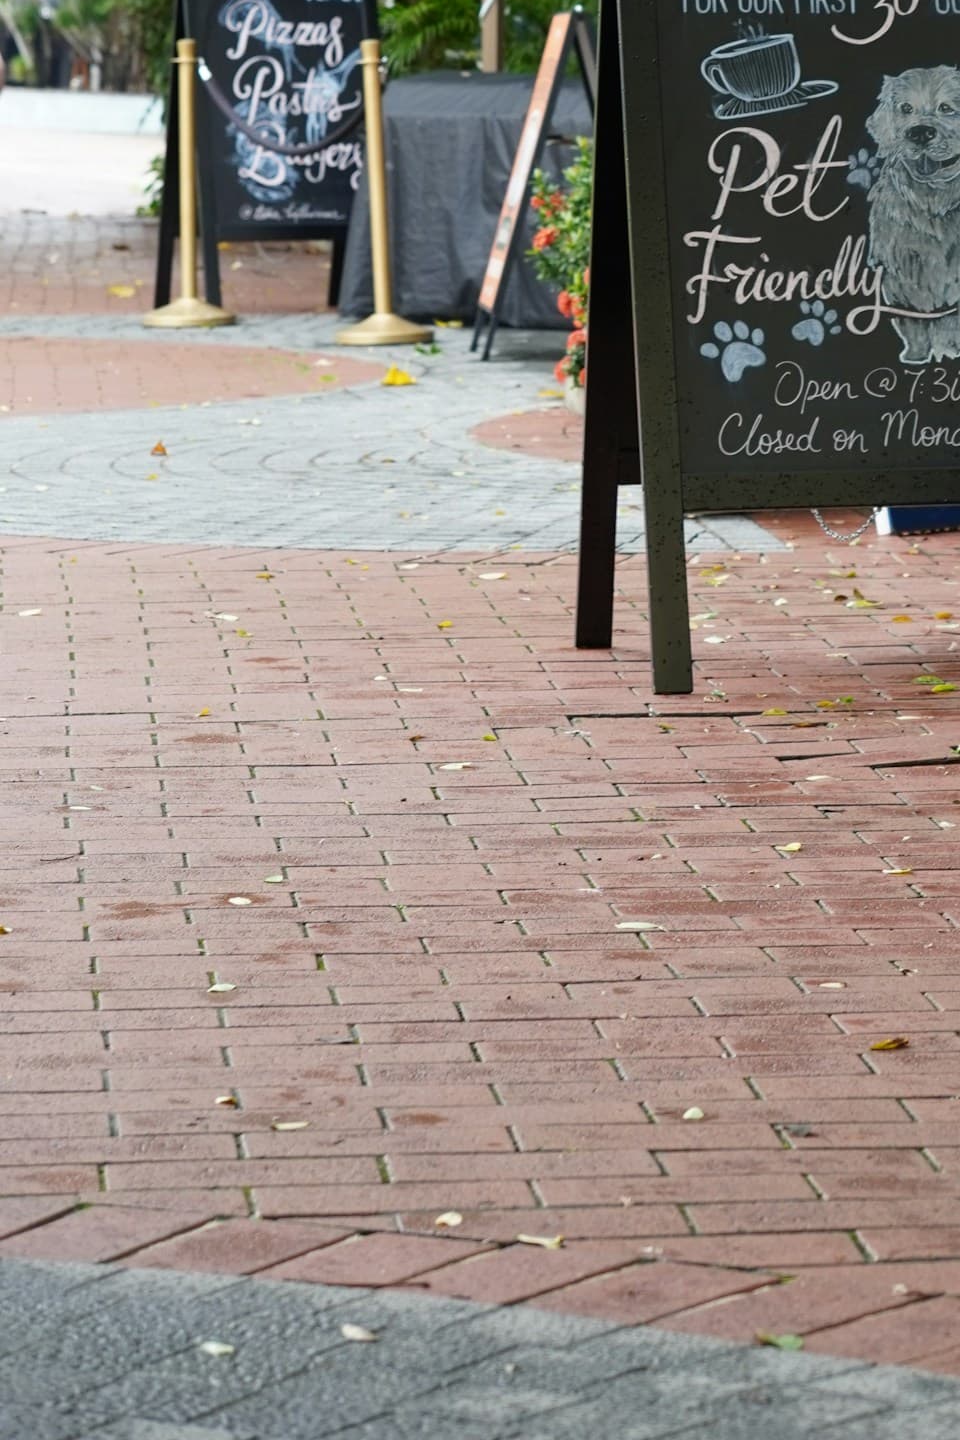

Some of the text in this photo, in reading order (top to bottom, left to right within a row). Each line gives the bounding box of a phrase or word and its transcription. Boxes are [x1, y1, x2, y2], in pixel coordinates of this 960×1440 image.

[232, 55, 362, 127] Pastas
[707, 114, 851, 221] Pet
[683, 224, 957, 335] Friendly
[774, 360, 859, 414] Open
[863, 366, 898, 398] @
[718, 412, 822, 456] Closed
[833, 427, 869, 454] on
